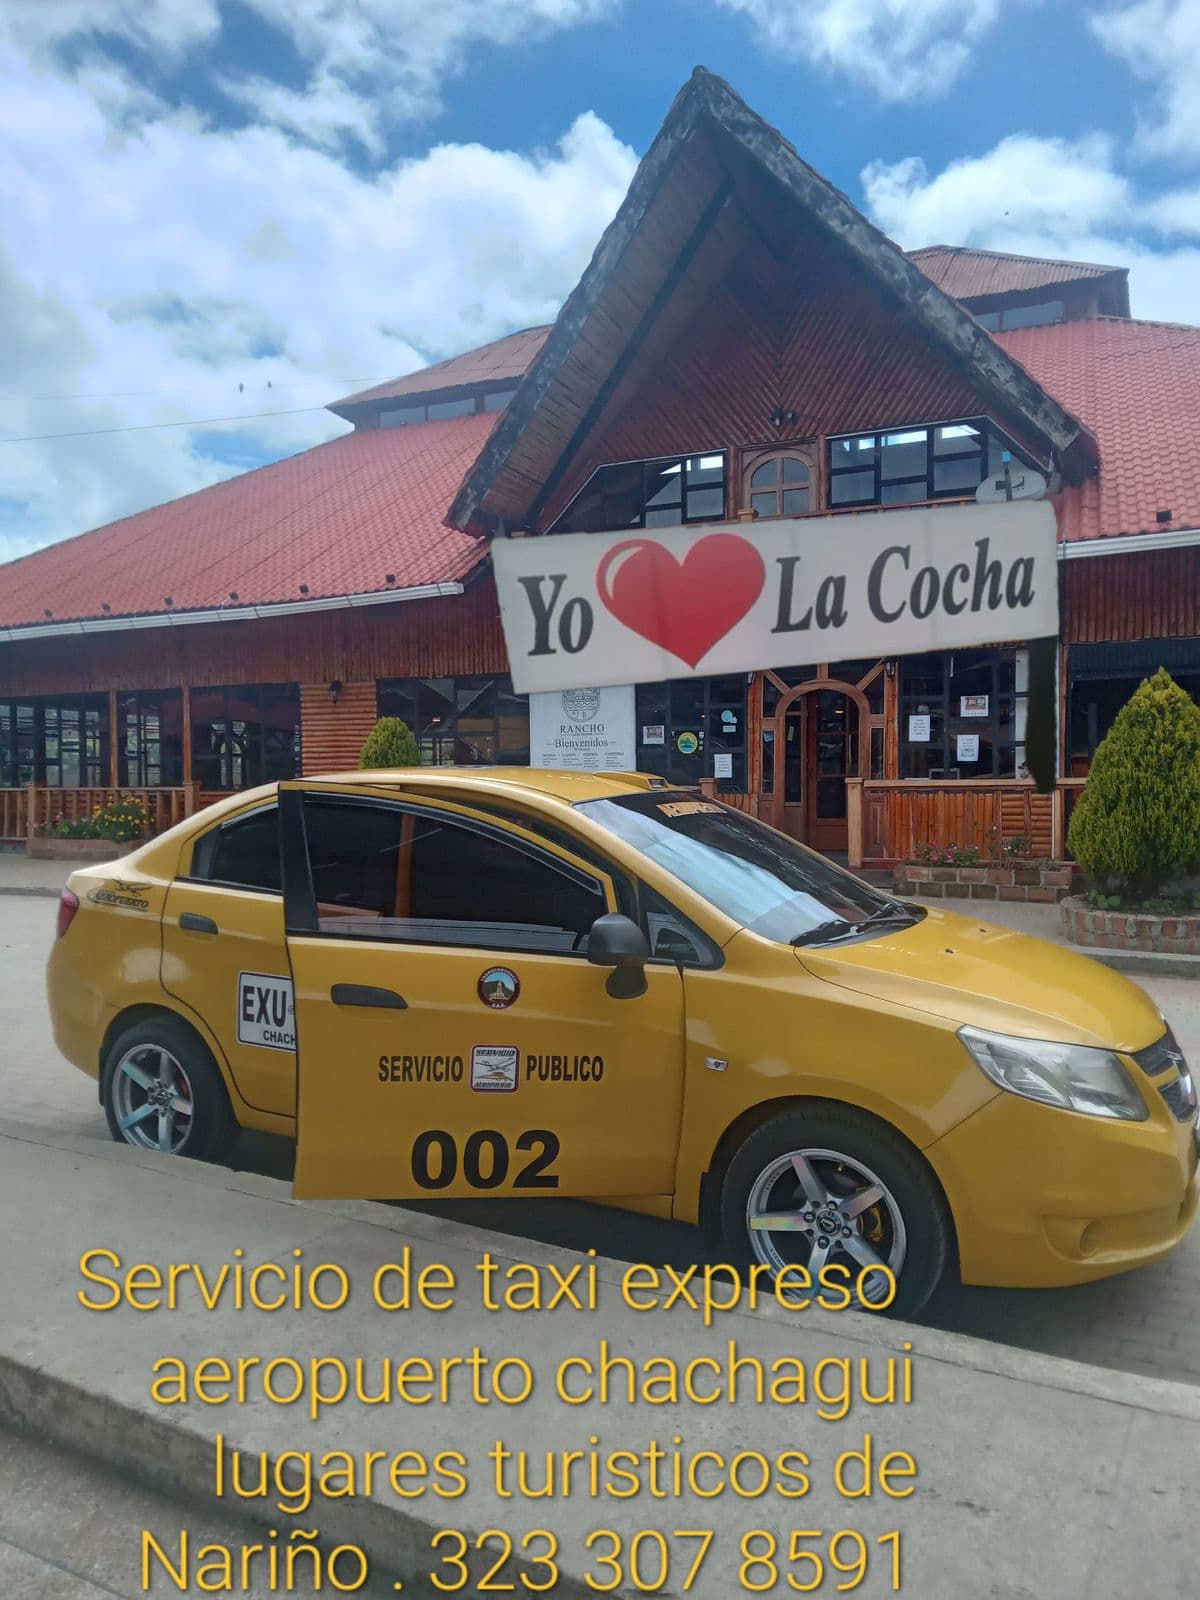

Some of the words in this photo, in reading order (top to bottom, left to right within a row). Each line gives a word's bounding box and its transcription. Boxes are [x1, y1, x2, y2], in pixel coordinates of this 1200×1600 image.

[517, 574, 594, 656] Yo
[770, 556, 848, 634] La
[867, 537, 1035, 624] Cocha
[554, 737, 610, 748] Bienvenidos
[560, 723, 605, 734] RANCHO
[242, 985, 287, 1027] EXU
[378, 1055, 464, 1083] SERVICIO
[526, 1055, 604, 1082] PUBLICO
[411, 1129, 561, 1190] 002
